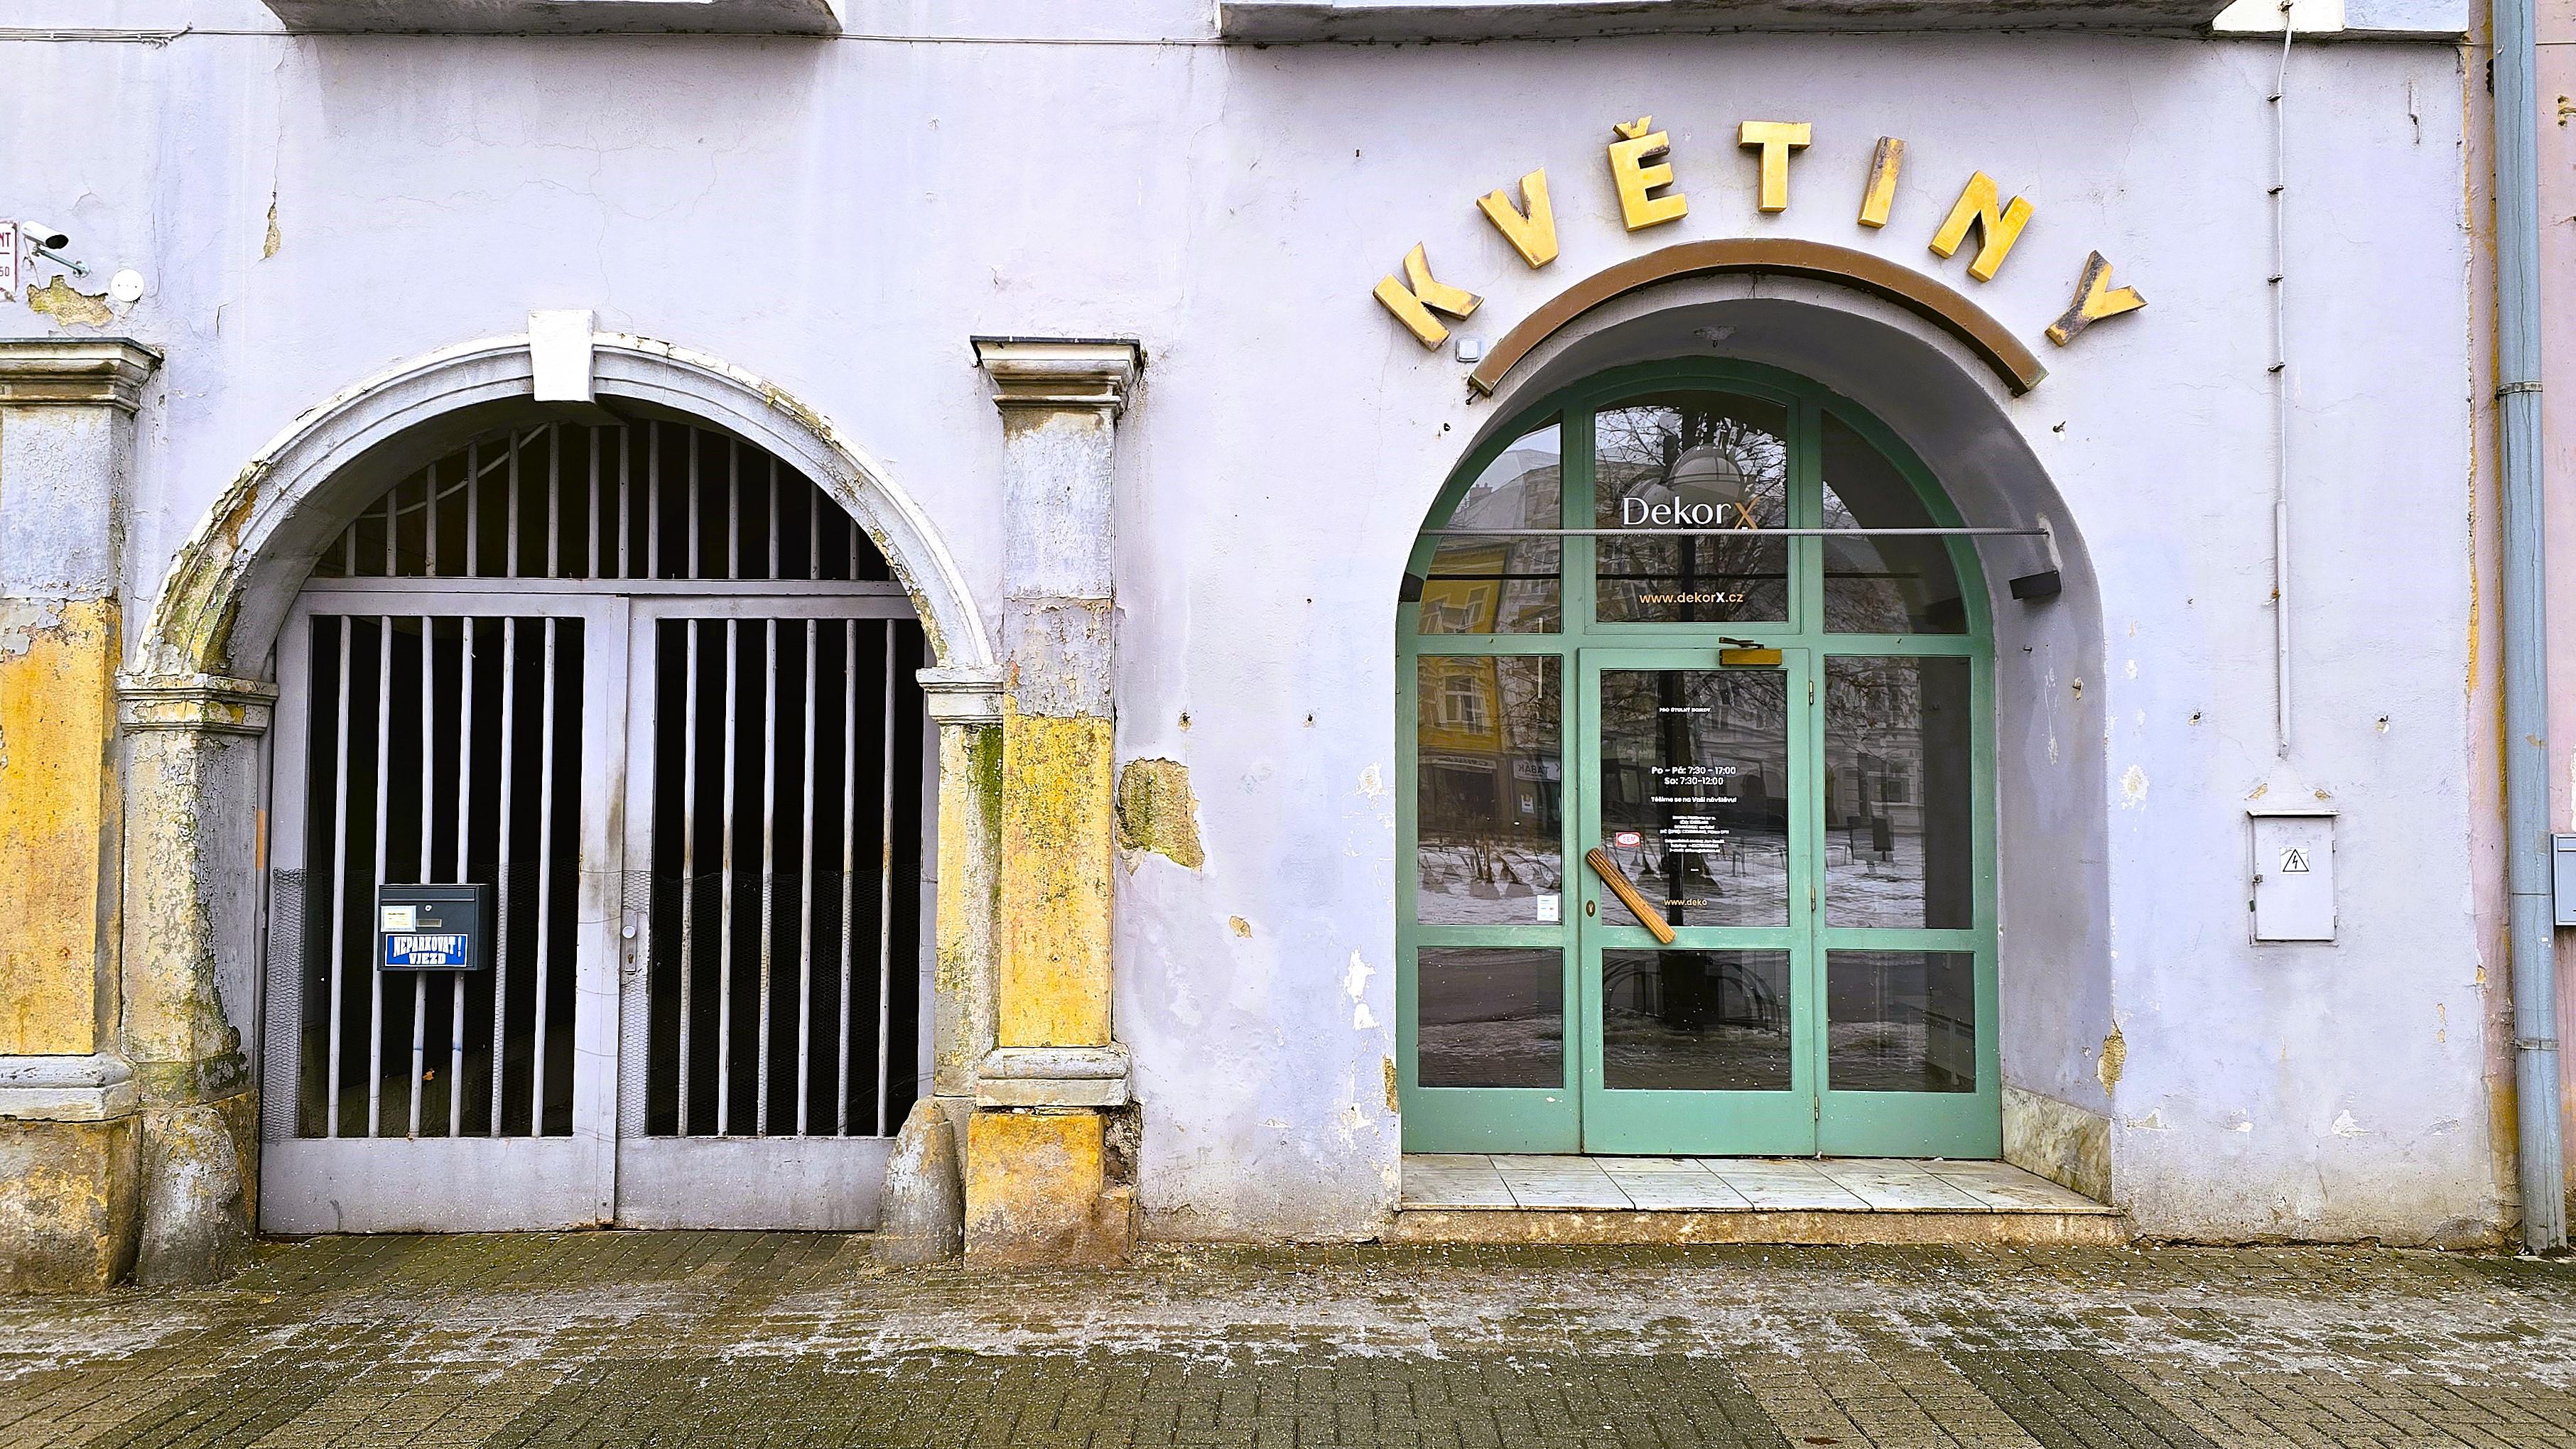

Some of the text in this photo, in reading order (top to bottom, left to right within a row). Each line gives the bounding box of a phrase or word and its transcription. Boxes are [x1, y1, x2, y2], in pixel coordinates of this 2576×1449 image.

[1373, 114, 2148, 352] KVĚTINY
[1639, 592, 1743, 603] www.dekorX.cz
[408, 953, 446, 965] VJEZD
